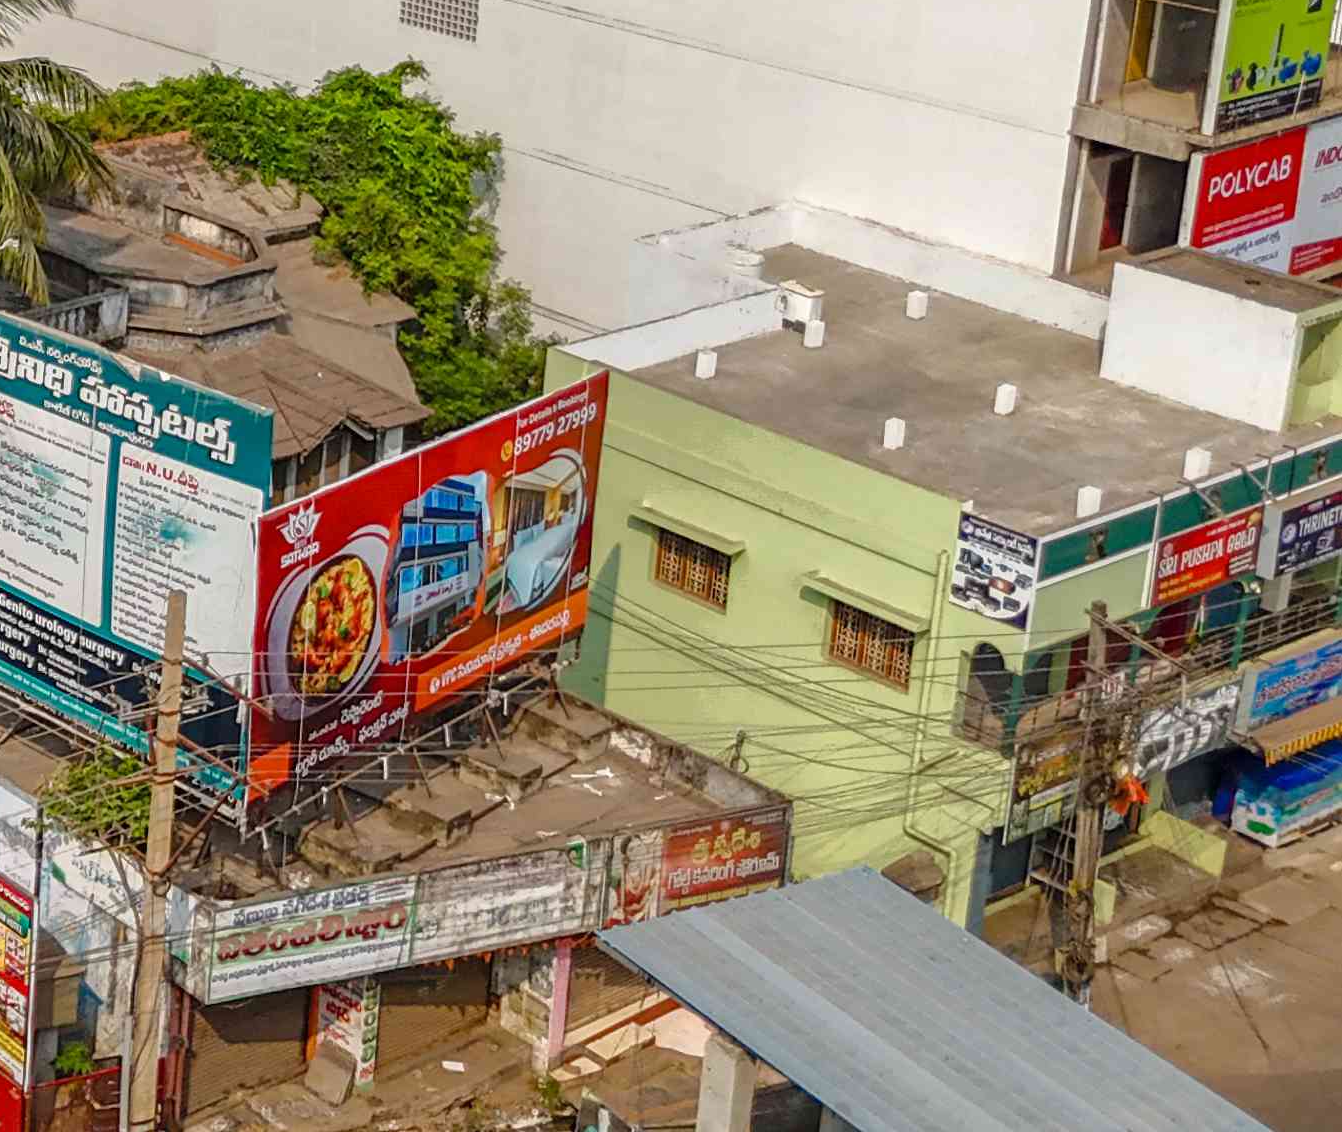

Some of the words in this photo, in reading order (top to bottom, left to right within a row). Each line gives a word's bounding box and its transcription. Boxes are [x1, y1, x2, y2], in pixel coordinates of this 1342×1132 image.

[1207, 154, 1292, 203] POLYCAB
[1299, 506, 1342, 538] THRINET
[1158, 554, 1178, 579] SRI
[35, 608, 78, 646] urology
[79, 631, 124, 666] surgery
